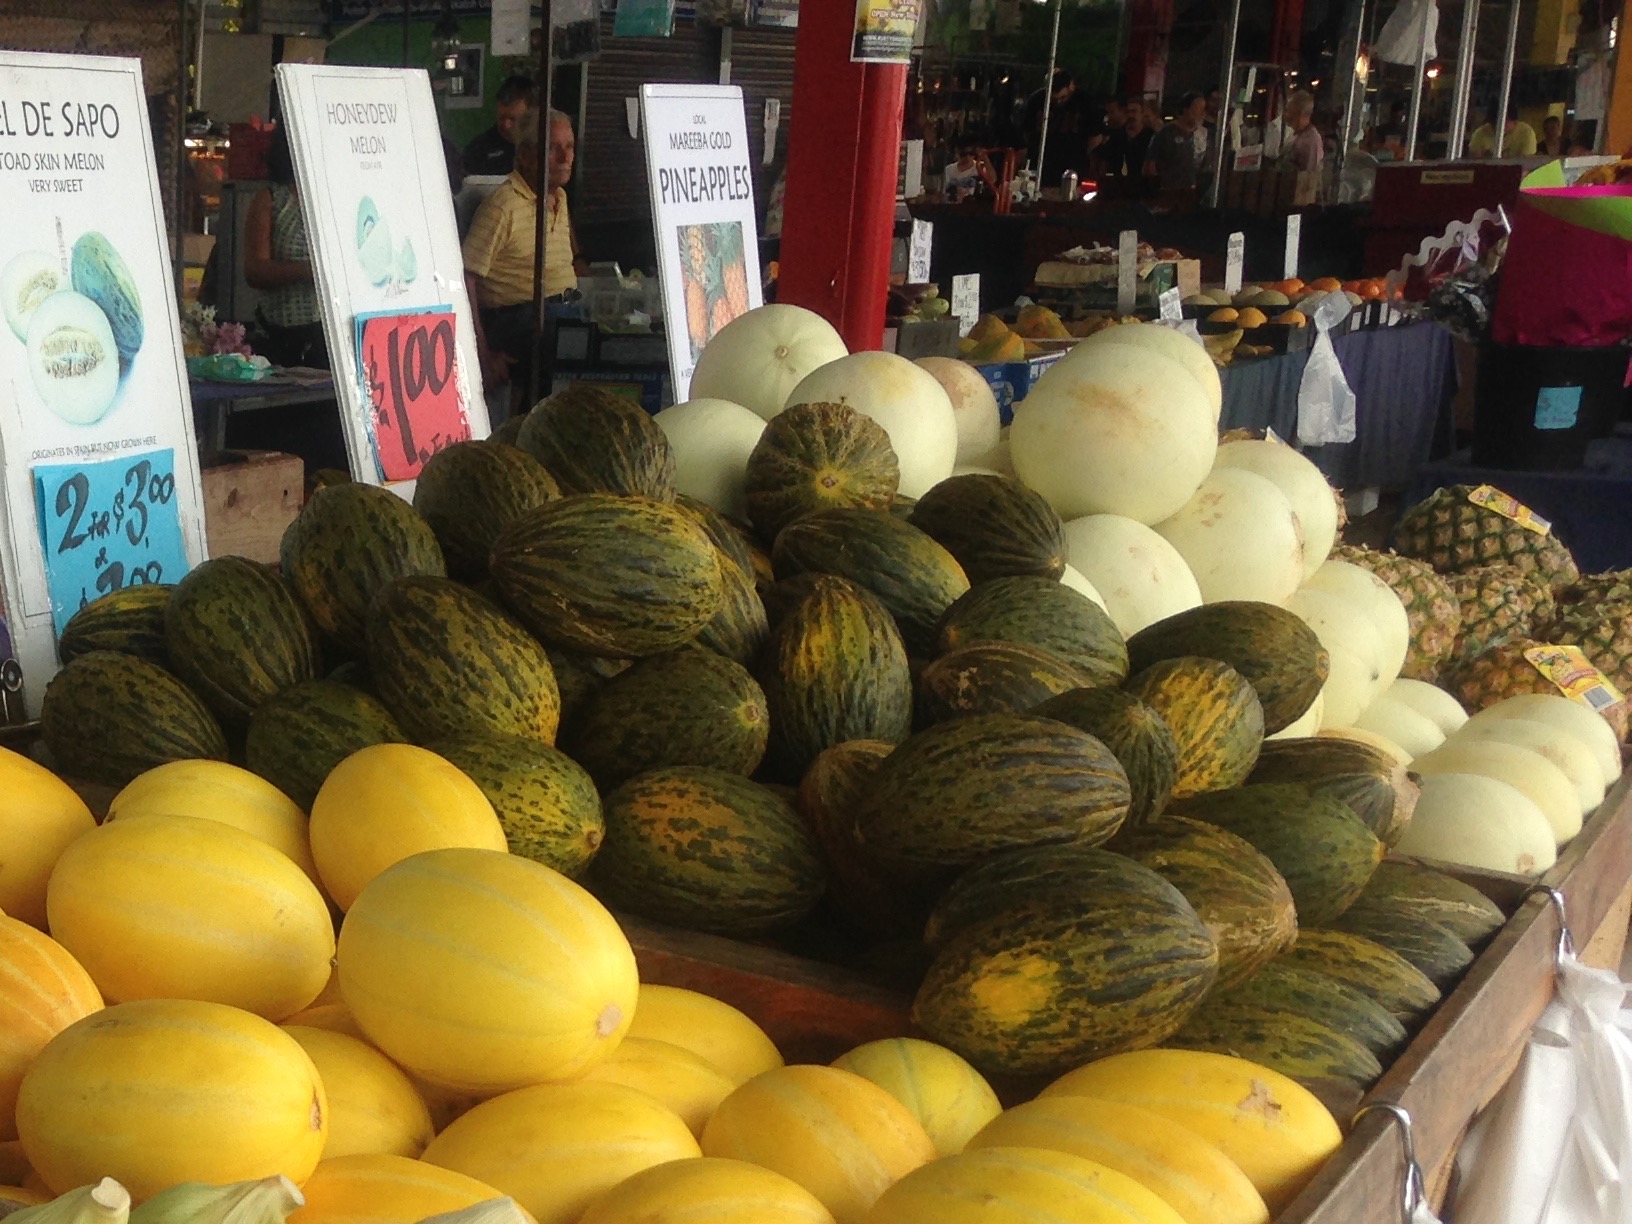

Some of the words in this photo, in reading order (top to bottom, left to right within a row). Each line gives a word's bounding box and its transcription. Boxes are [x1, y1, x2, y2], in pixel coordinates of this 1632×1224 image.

[22, 101, 54, 136] DE
[60, 101, 120, 138] SAPO
[326, 103, 397, 124] HONEYDEW
[349, 136, 387, 154] MELON
[669, 131, 709, 150] MAREEBA
[709, 131, 732, 149] GOLD
[35, 153, 60, 170] SKIN
[64, 153, 105, 170] MELON
[28, 180, 50, 192] VERY
[53, 179, 83, 192] SWEET
[659, 165, 750, 204] PINEAPPLES
[121, 438, 142, 449] GROWN
[143, 435, 158, 447] HERE
[55, 473, 90, 555] 2
